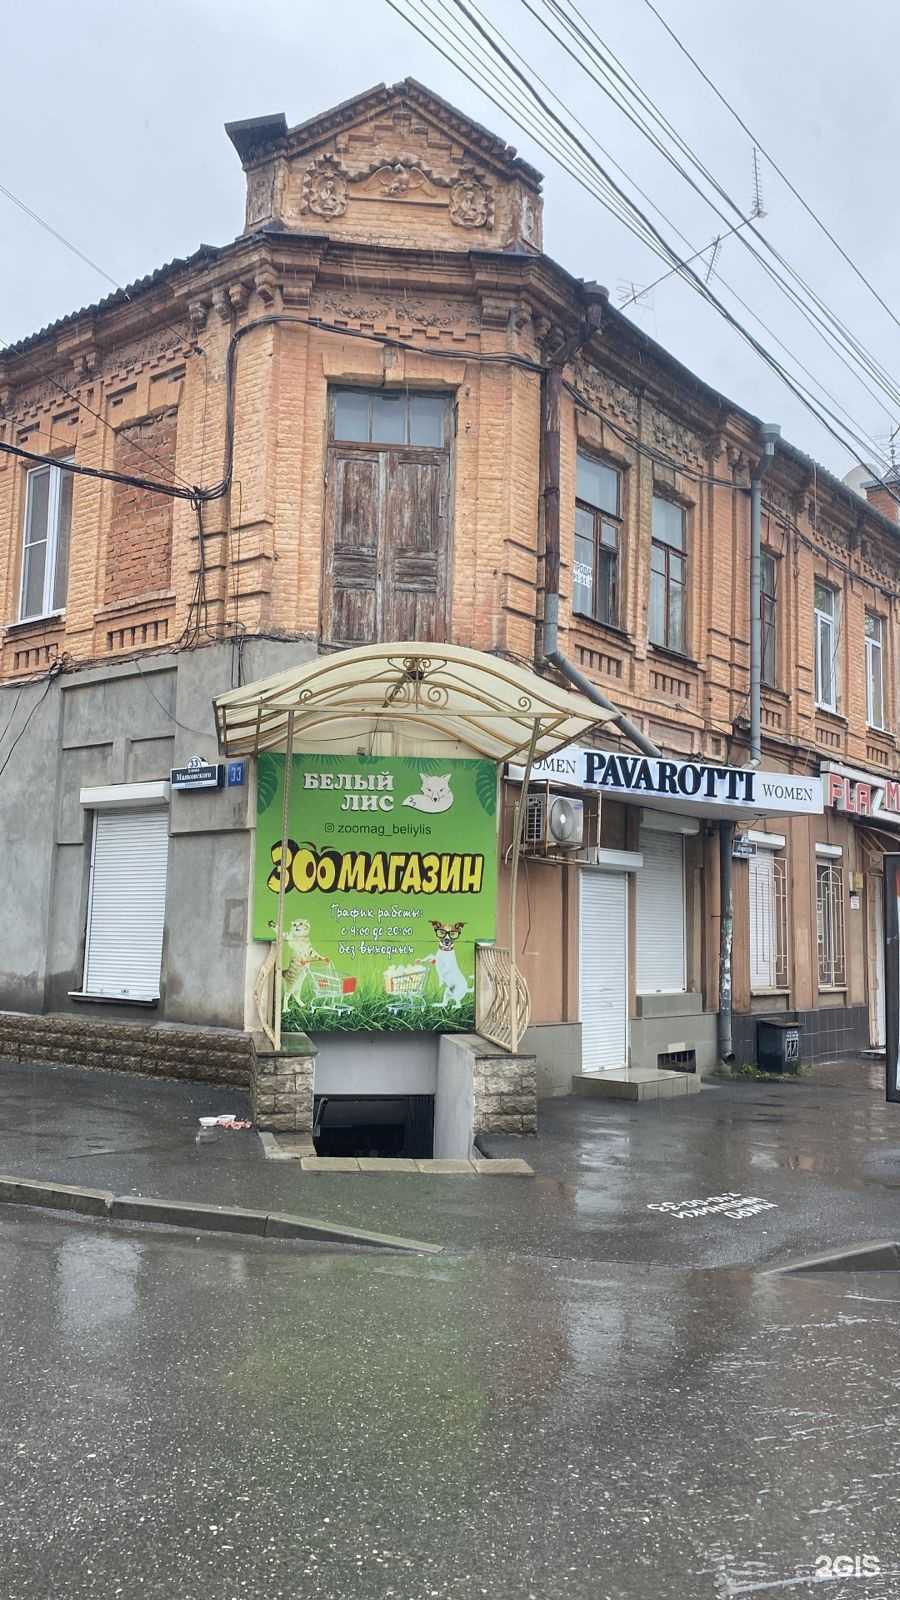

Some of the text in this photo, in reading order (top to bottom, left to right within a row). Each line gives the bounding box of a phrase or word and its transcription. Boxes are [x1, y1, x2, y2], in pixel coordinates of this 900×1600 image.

[231, 767, 242, 782] 33
[303, 771, 394, 790] БЕЛЫЙ
[532, 752, 813, 802] OMEN PAVAROTTI WOMEN
[341, 794, 394, 811] ЛИС
[337, 823, 432, 837] zoomag_beliylis
[267, 840, 485, 895] ЗООМАГАЗИН
[331, 903, 374, 922] График
[373, 926, 384, 941] до
[387, 926, 413, 937] 20:00
